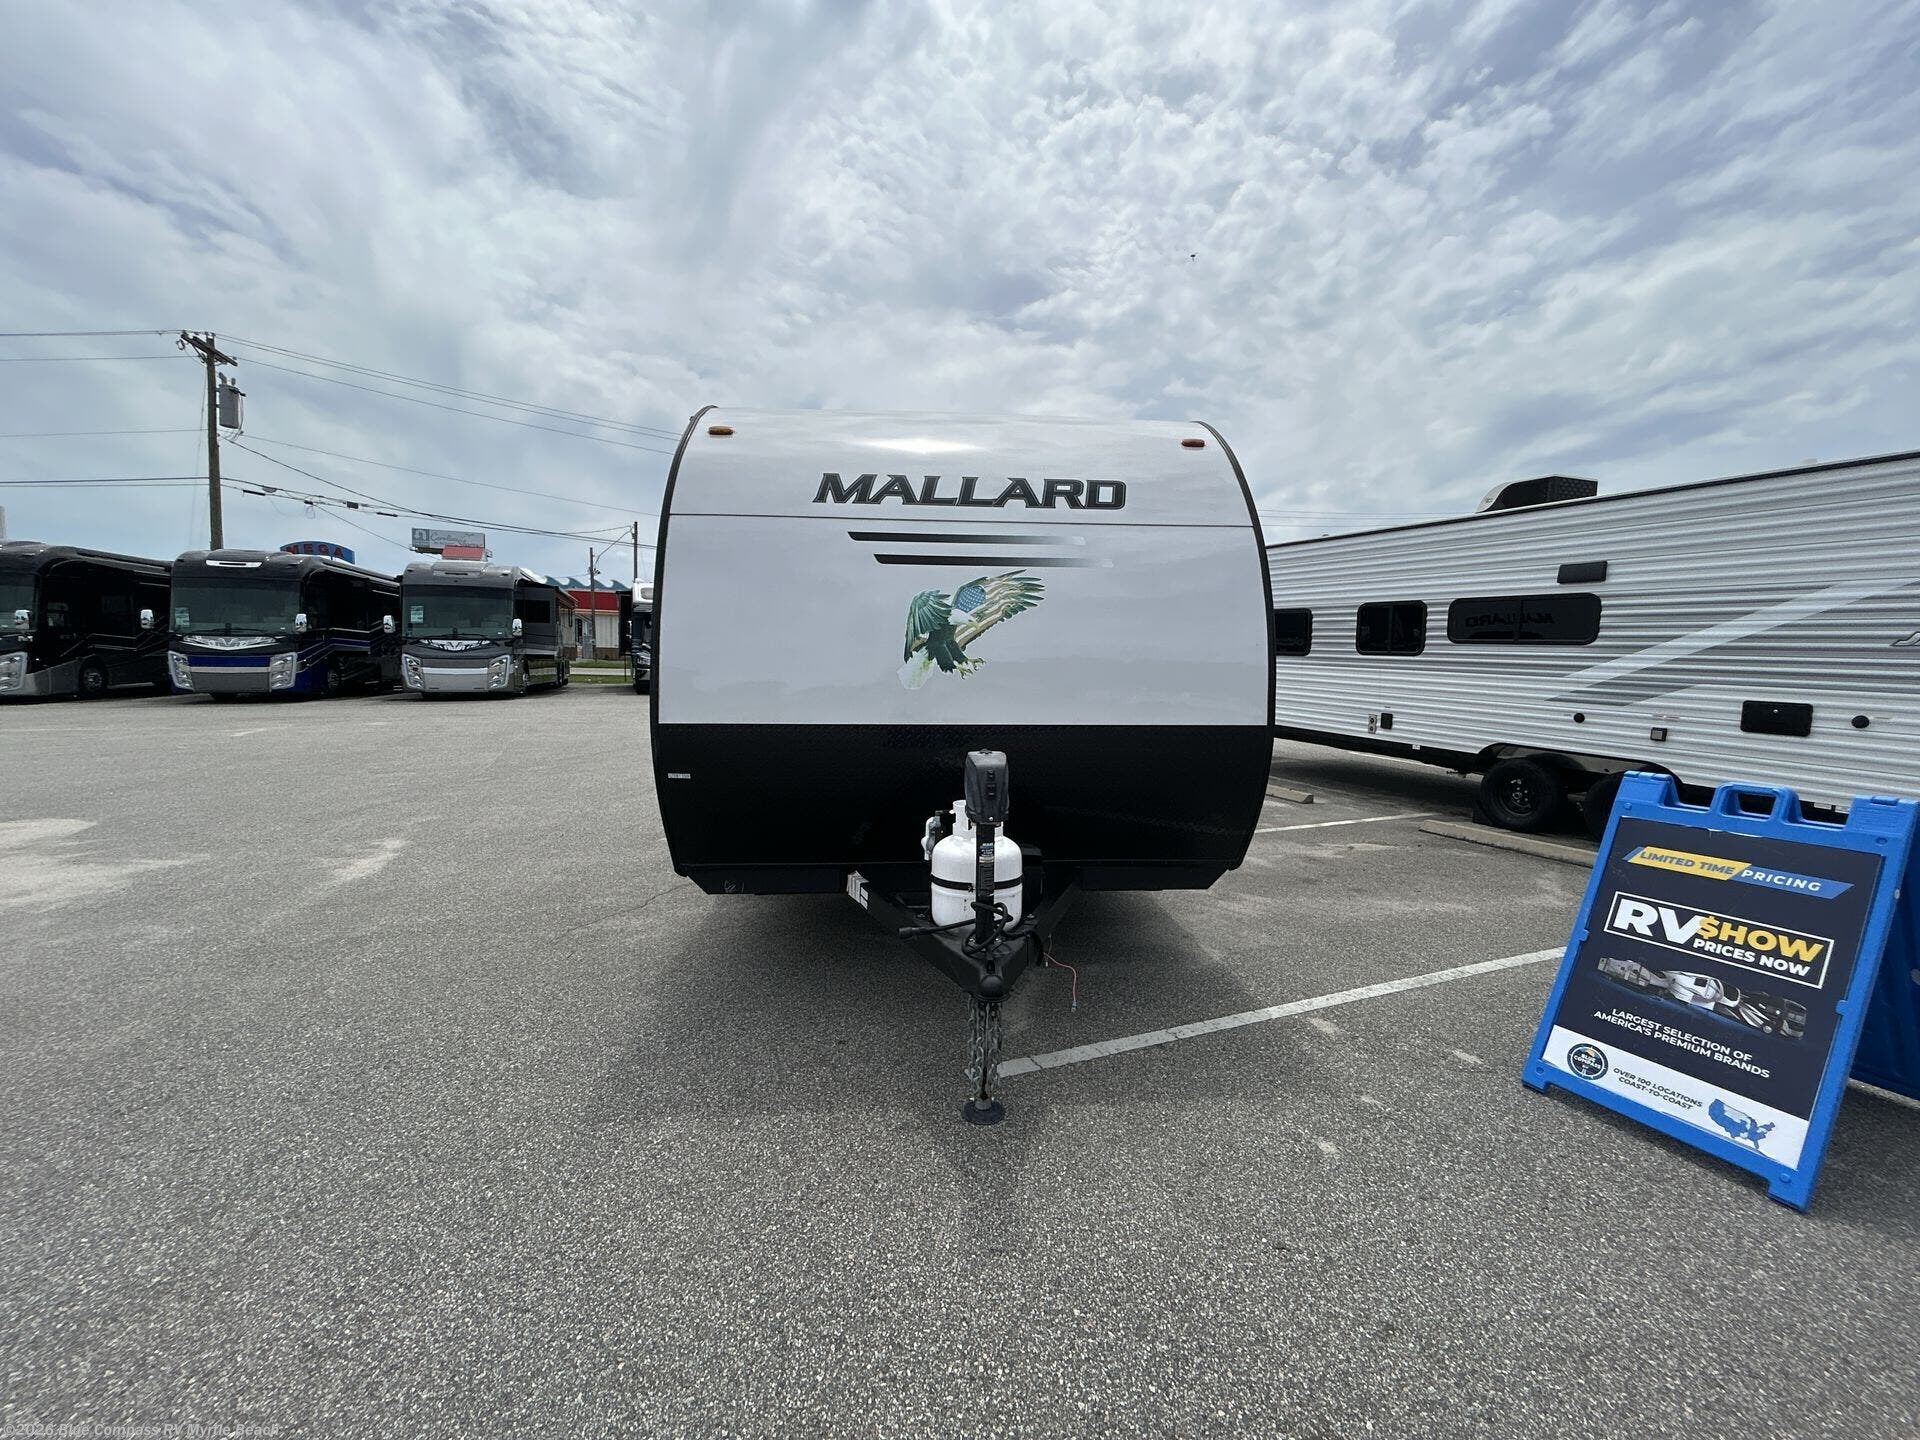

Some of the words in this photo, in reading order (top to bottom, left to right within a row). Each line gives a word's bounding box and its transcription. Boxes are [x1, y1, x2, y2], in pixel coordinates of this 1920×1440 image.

[812, 473, 1126, 509] MALLARD
[1640, 851, 1695, 868] LIMITED
[1700, 862, 1735, 876] TIME
[1741, 869, 1821, 892] PRICING
[1613, 898, 1705, 945] RV
[1693, 938, 1756, 963] PRICES
[1759, 956, 1811, 977] NOW
[1594, 1011, 1652, 1036] AMERICA'S
[1654, 1031, 1711, 1058] PREMIUM
[1714, 1053, 1771, 1079] BRANDS
[1612, 1008, 1662, 1031] LARGEST
[1663, 1026, 1731, 1056] SELECTION
[1733, 1050, 1753, 1062] OF
[1613, 1067, 1636, 1081] OVER
[1637, 1077, 1652, 1087] 100
[1652, 1083, 1703, 1108] LOCATIONS
[1618, 1076, 1694, 1110] COAST-TO-COAST
